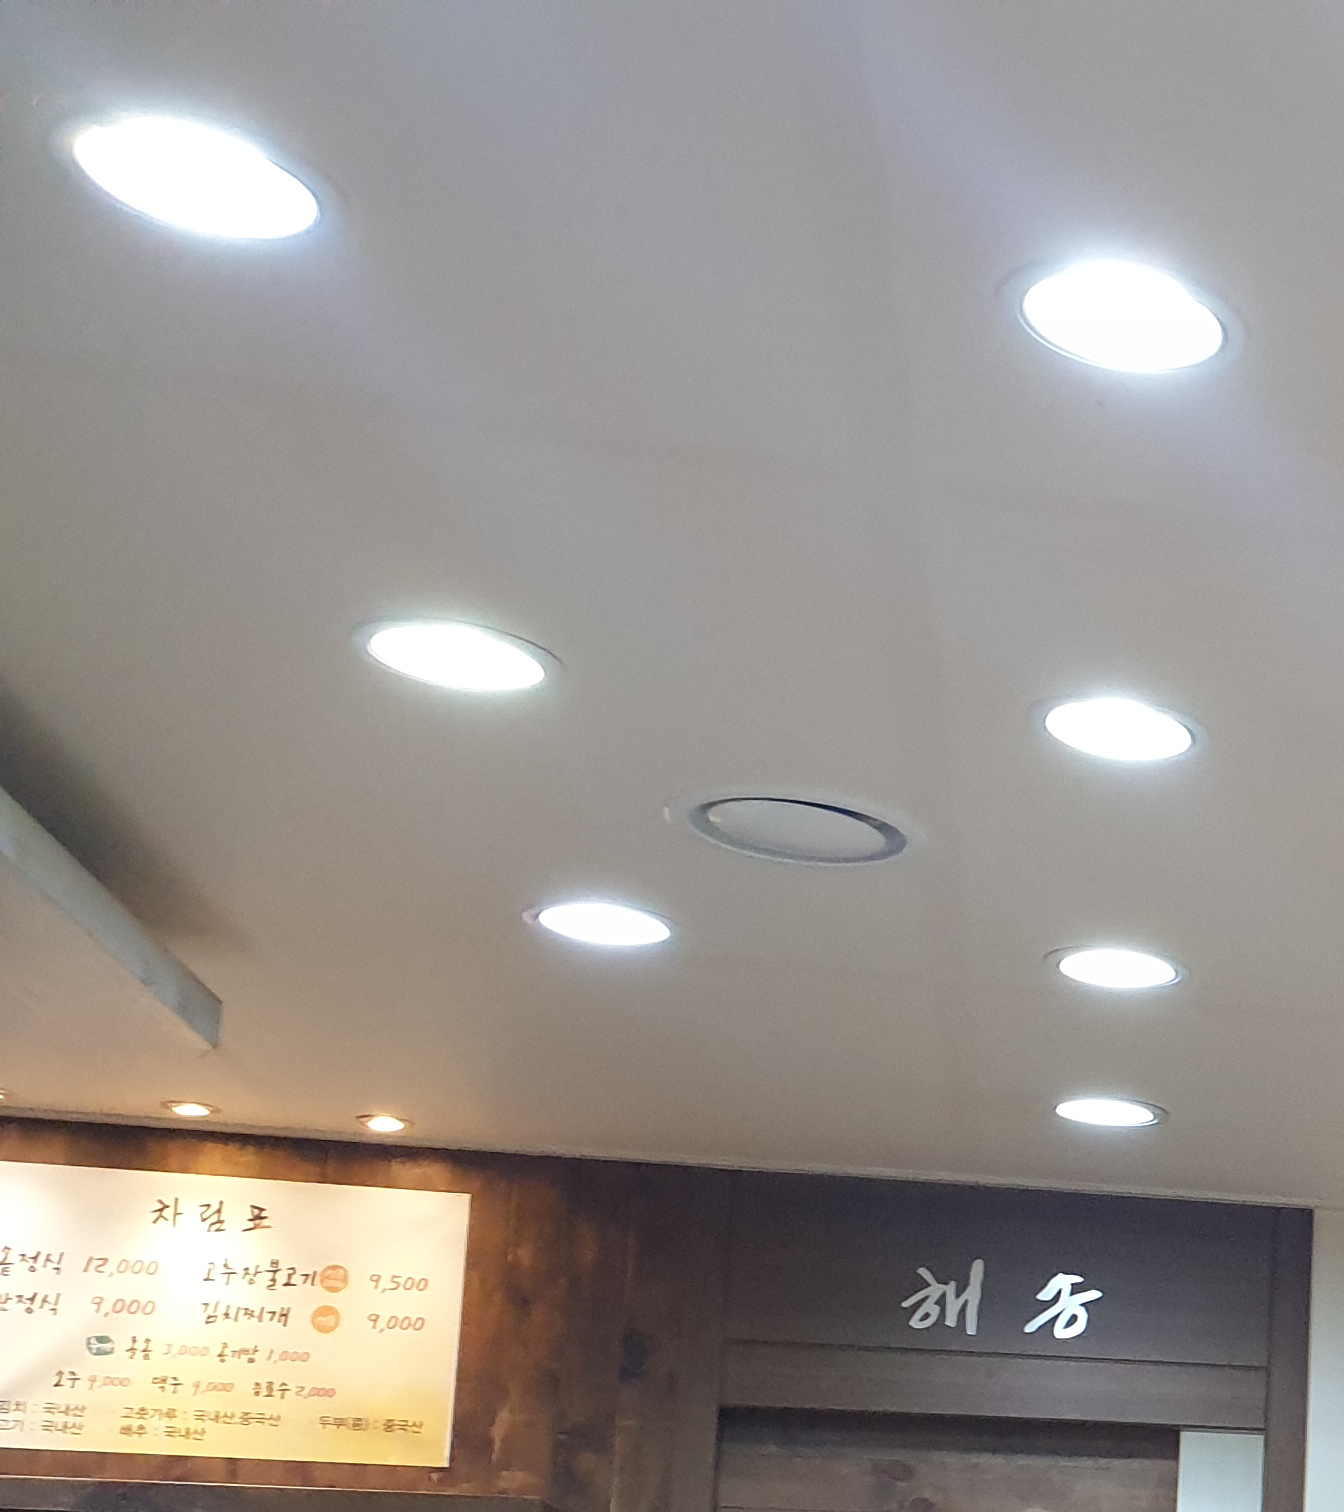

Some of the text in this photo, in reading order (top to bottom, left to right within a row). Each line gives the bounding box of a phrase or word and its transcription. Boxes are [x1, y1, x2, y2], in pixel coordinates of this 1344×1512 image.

[151, 1198, 272, 1233] 차림표
[83, 1255, 159, 1277] 12,000
[369, 1273, 429, 1293] 9,500
[90, 1295, 156, 1317] 9,000
[201, 1301, 426, 1334] 김치찌개 9,000
[53, 1370, 81, 1389] 소주
[151, 1375, 184, 1395] 맥주
